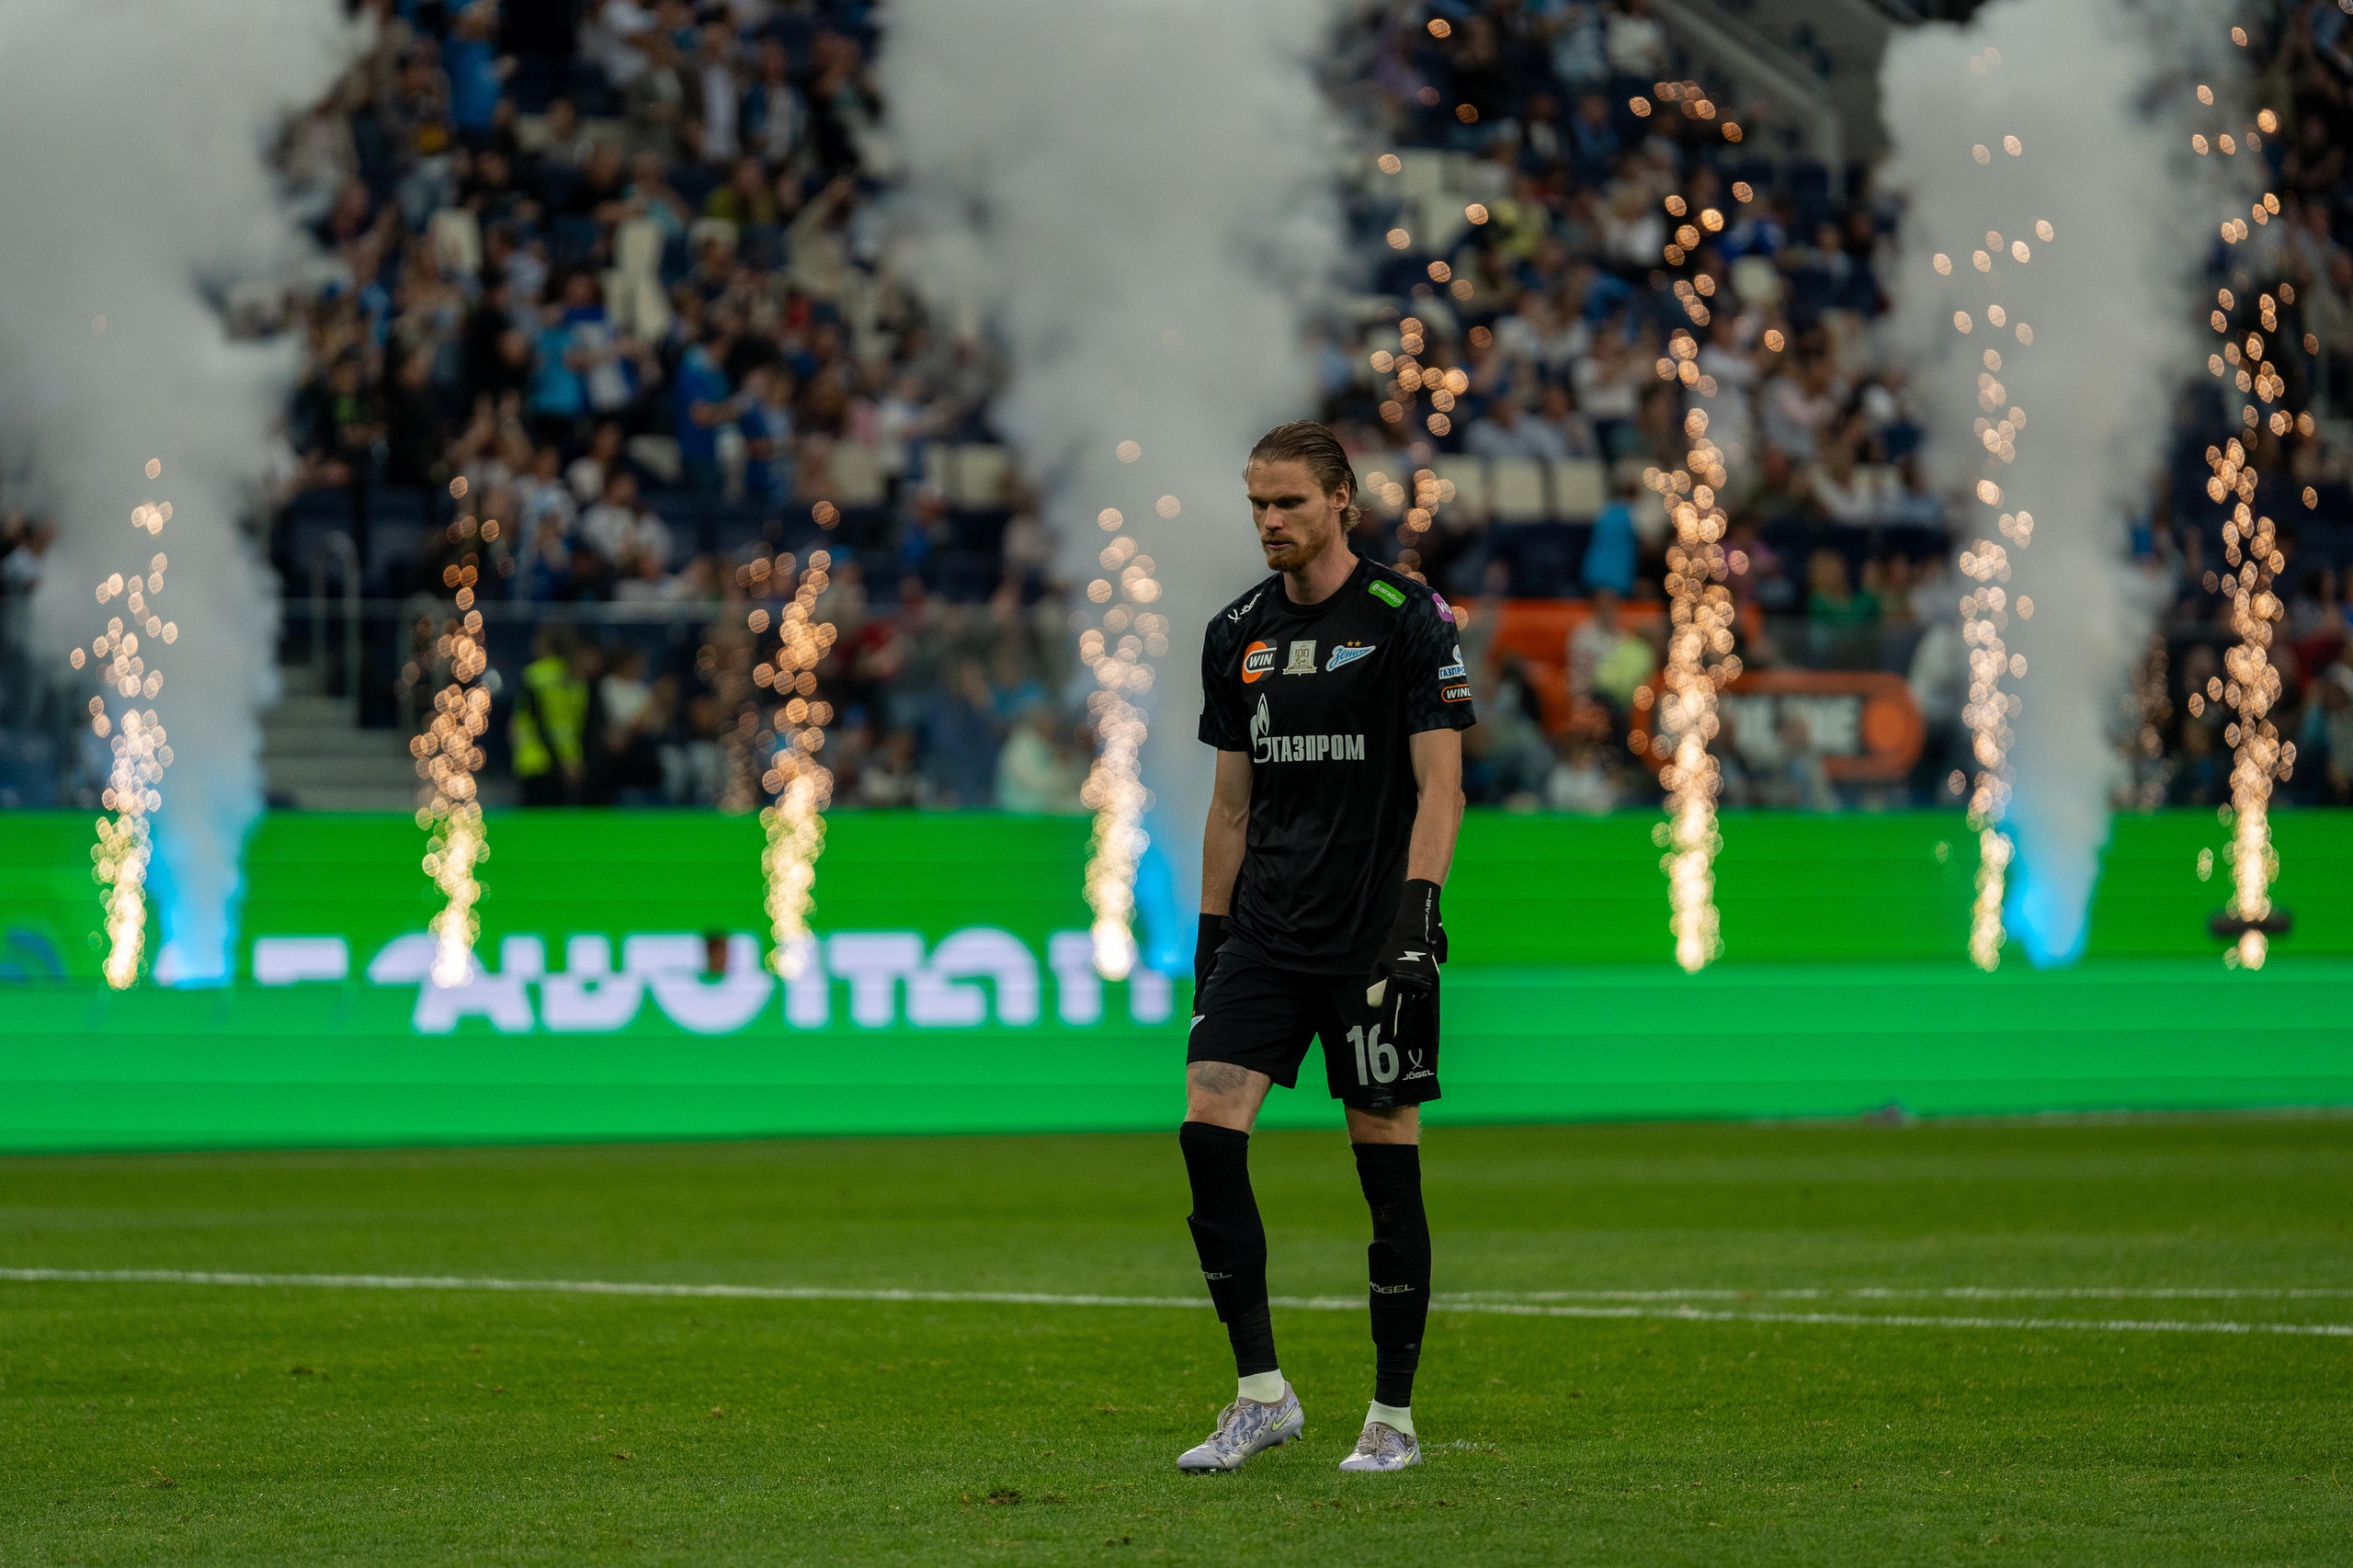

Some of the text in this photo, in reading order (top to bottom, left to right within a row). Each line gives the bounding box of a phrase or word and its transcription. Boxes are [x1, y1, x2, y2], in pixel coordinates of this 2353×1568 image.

[1249, 653, 1274, 668] WIN
[1271, 734, 1366, 763] ГАЗПРОМ
[1346, 1023, 1400, 1085] 16
[1402, 1069, 1435, 1081] JÖGEL
